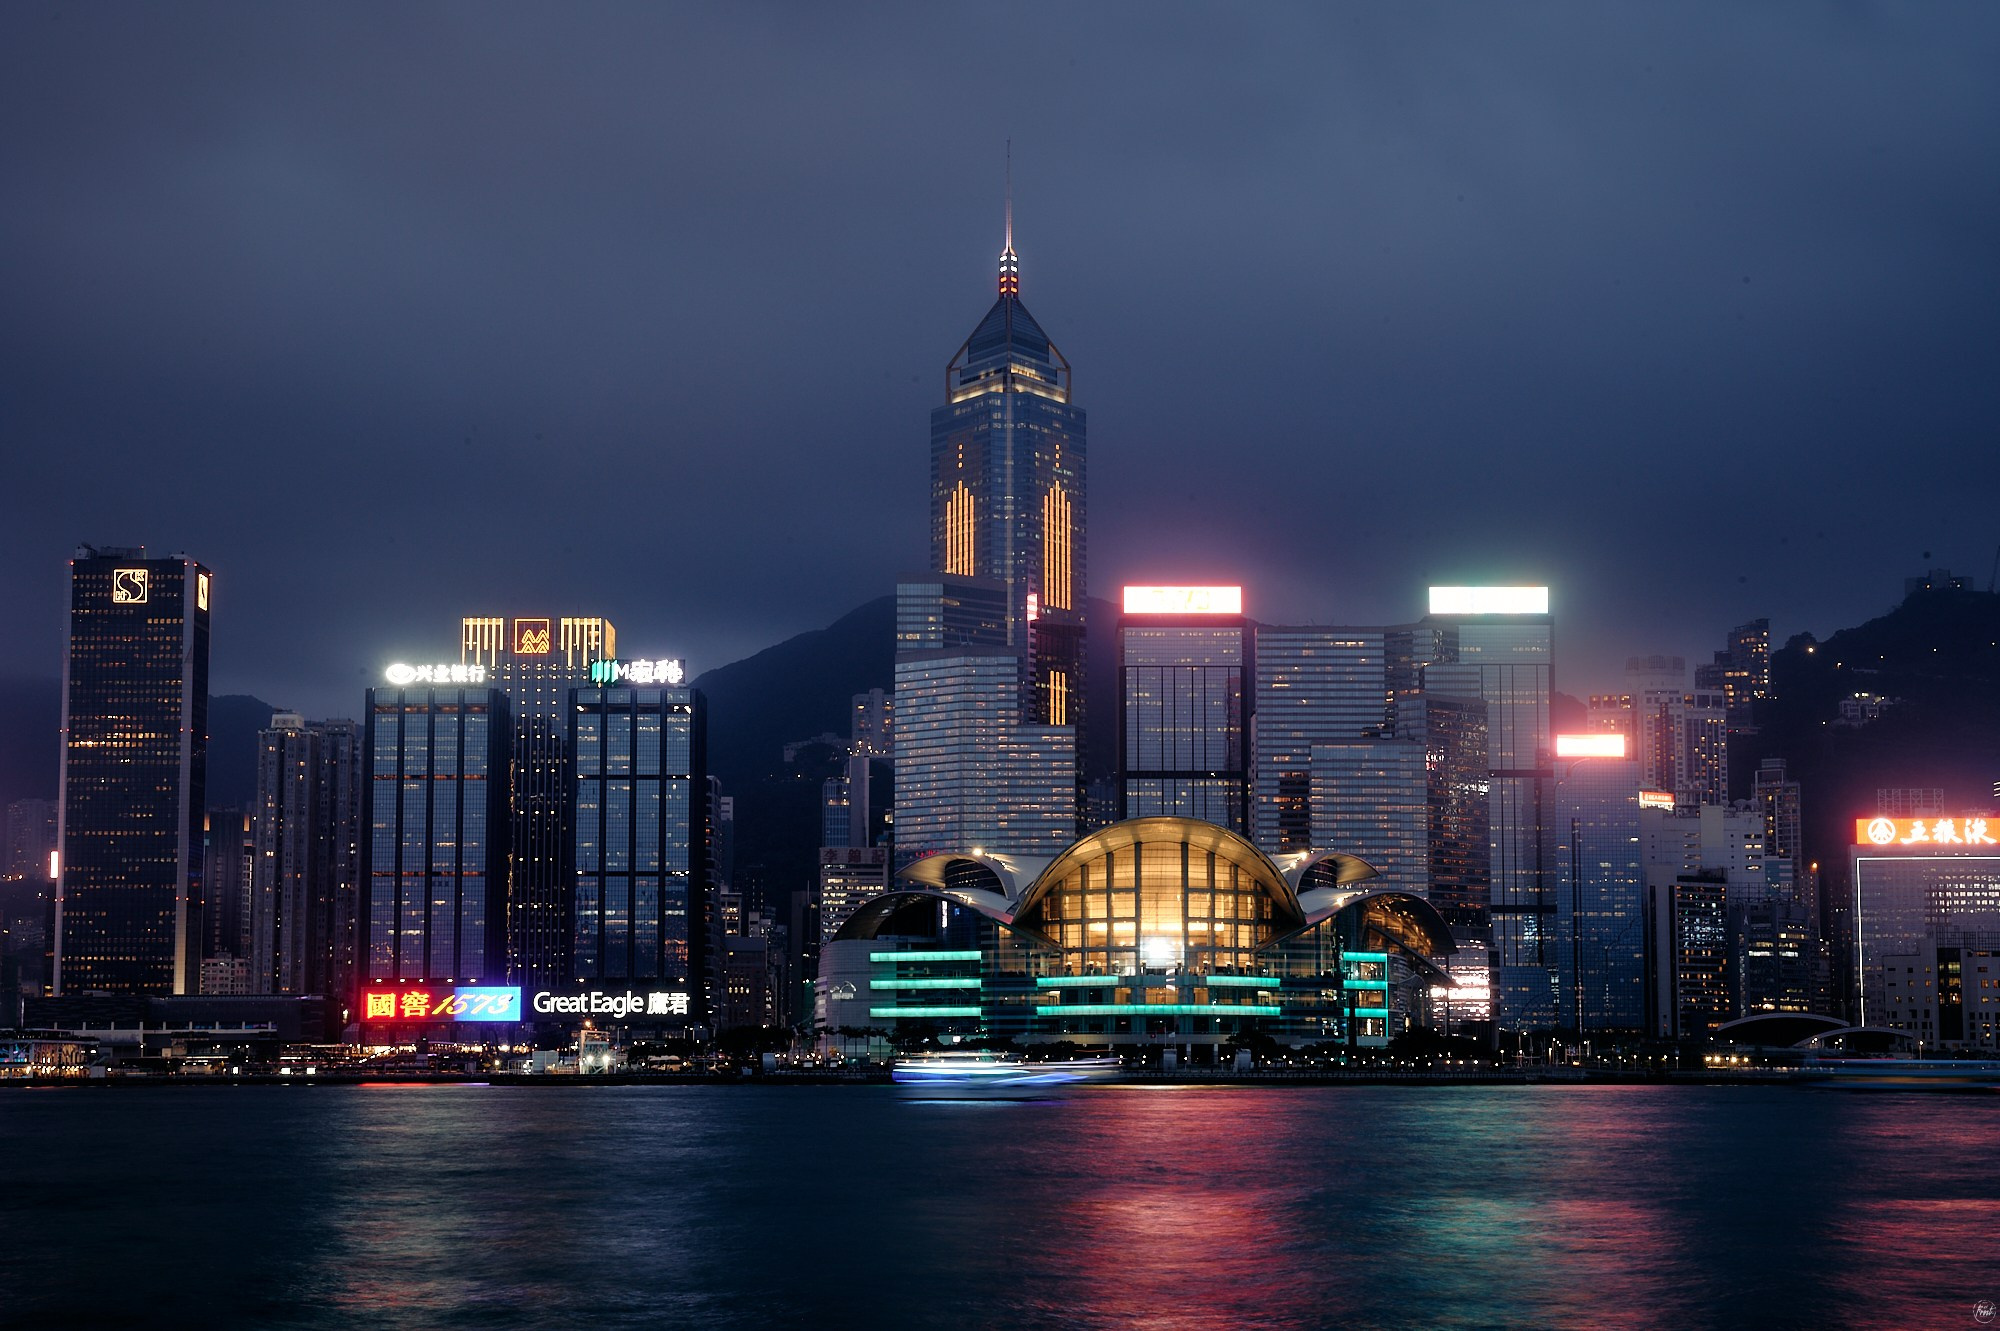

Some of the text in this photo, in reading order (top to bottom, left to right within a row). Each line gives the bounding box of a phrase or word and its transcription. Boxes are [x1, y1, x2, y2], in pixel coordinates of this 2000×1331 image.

[432, 994, 513, 1015] 1573
[533, 991, 690, 1018] Great Eagle 鷹君
